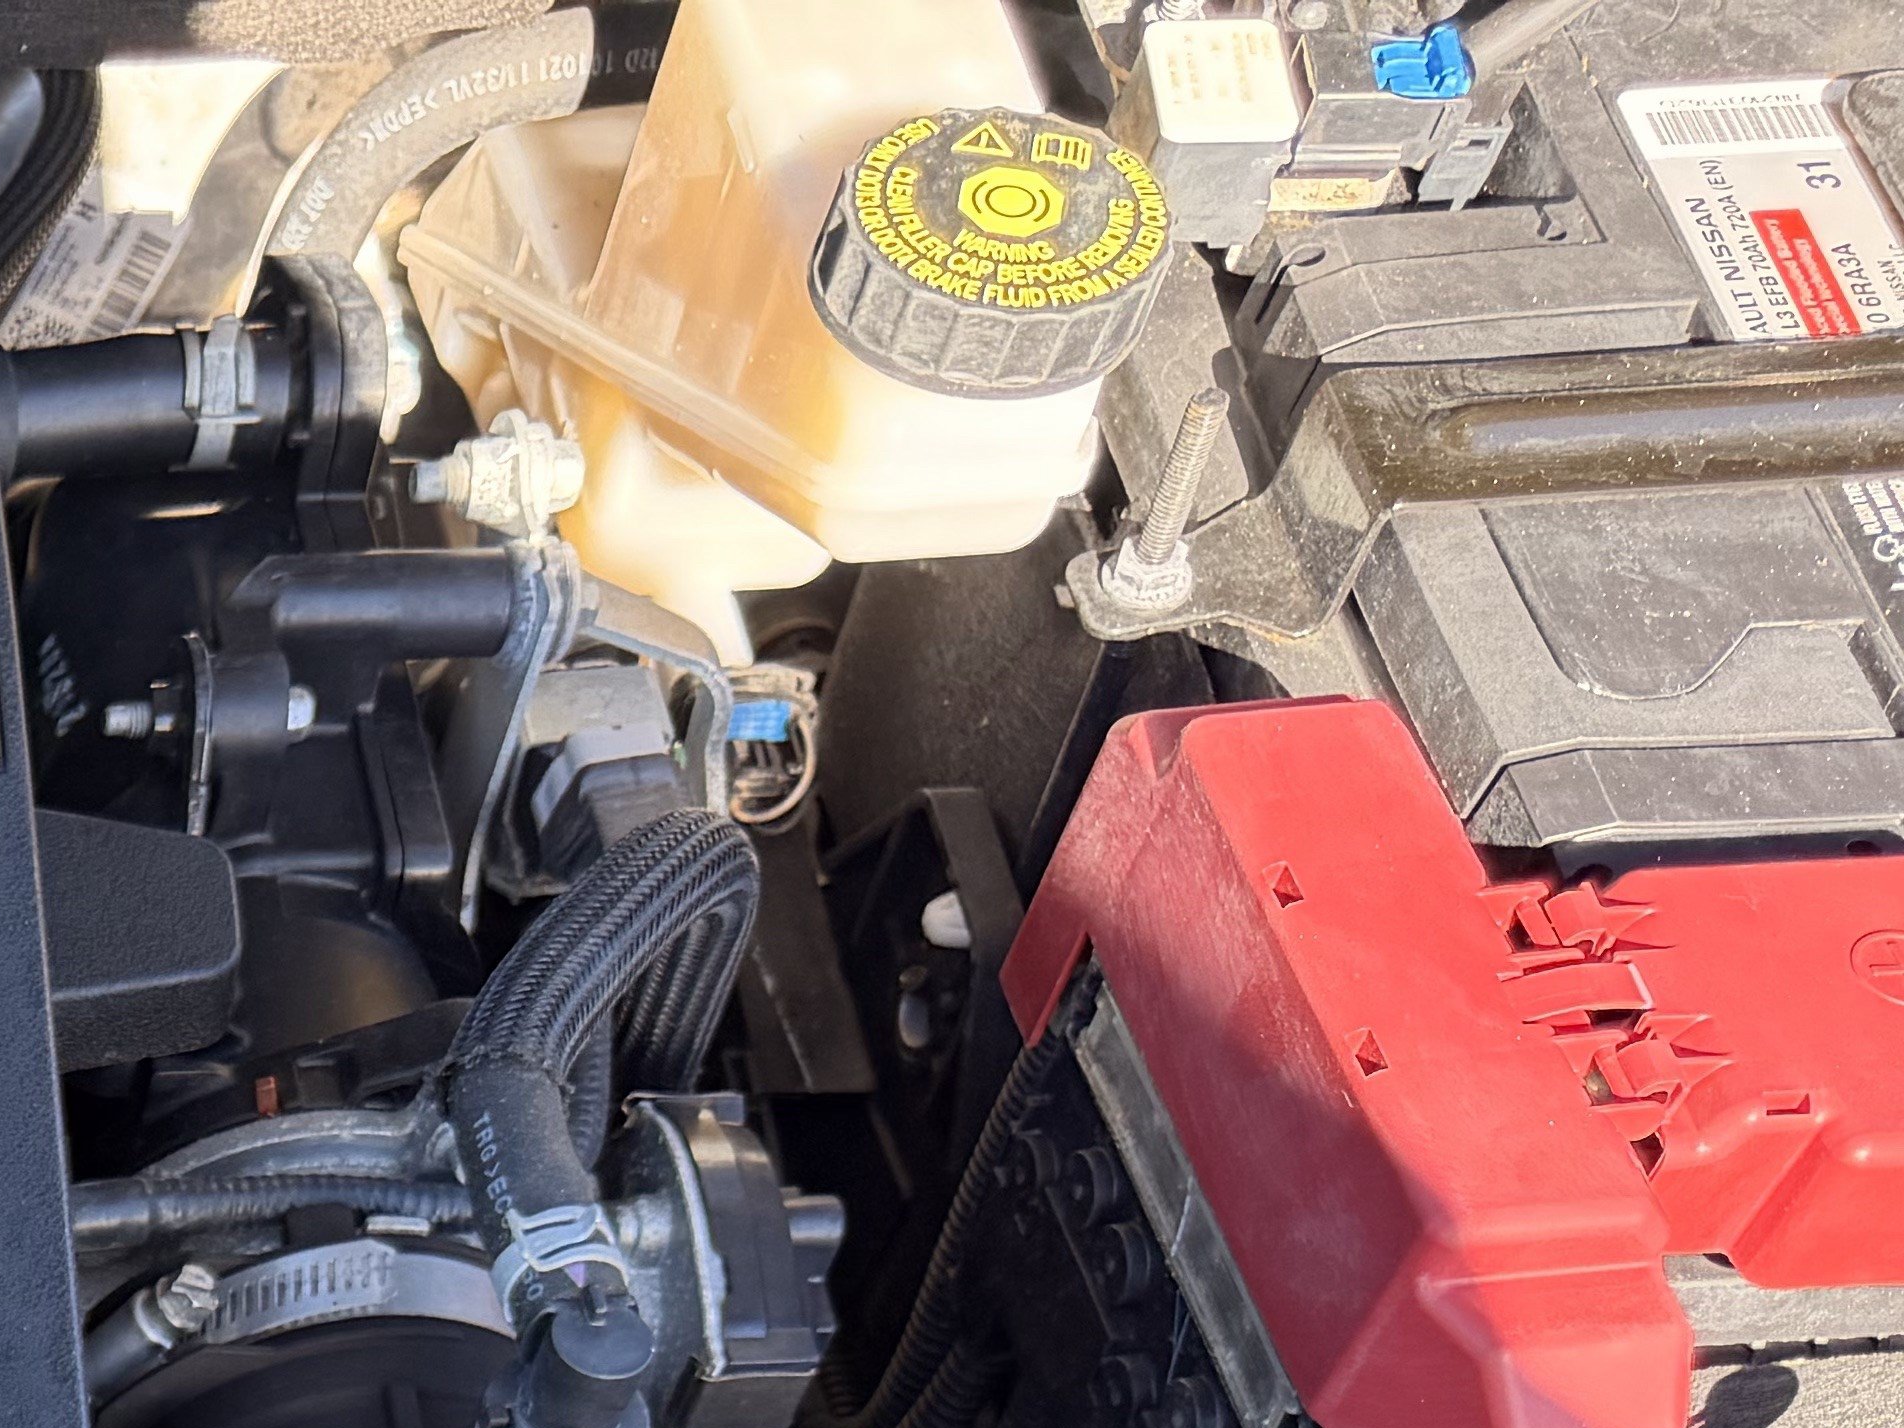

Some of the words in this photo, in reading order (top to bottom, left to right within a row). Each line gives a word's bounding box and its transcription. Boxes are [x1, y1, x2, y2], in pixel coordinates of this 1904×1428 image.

[893, 118, 940, 146] USE
[864, 136, 907, 173] ONLY
[886, 166, 919, 214] CLEAN
[1106, 148, 1168, 226] CONTAINER
[1699, 160, 1734, 190] (EN)
[1797, 161, 1842, 190] 31
[858, 207, 889, 235] OR
[1718, 194, 1750, 231] 720A
[892, 213, 953, 263] FILLER
[953, 229, 1056, 263] WARNING
[1077, 198, 1135, 270] REMOVING
[1685, 197, 1745, 281] NISSAN
[947, 252, 995, 279] CAP
[997, 256, 1087, 285] BEFORE
[1114, 225, 1165, 281] SEALED
[1739, 235, 1772, 271] 70Ah
[908, 258, 983, 301] BRAKE
[1047, 275, 1111, 307] FROM
[1103, 269, 1128, 291] A
[1758, 276, 1789, 306] EFB
[1831, 243, 1881, 307] 6RA3A
[982, 283, 1047, 308] FLUID
